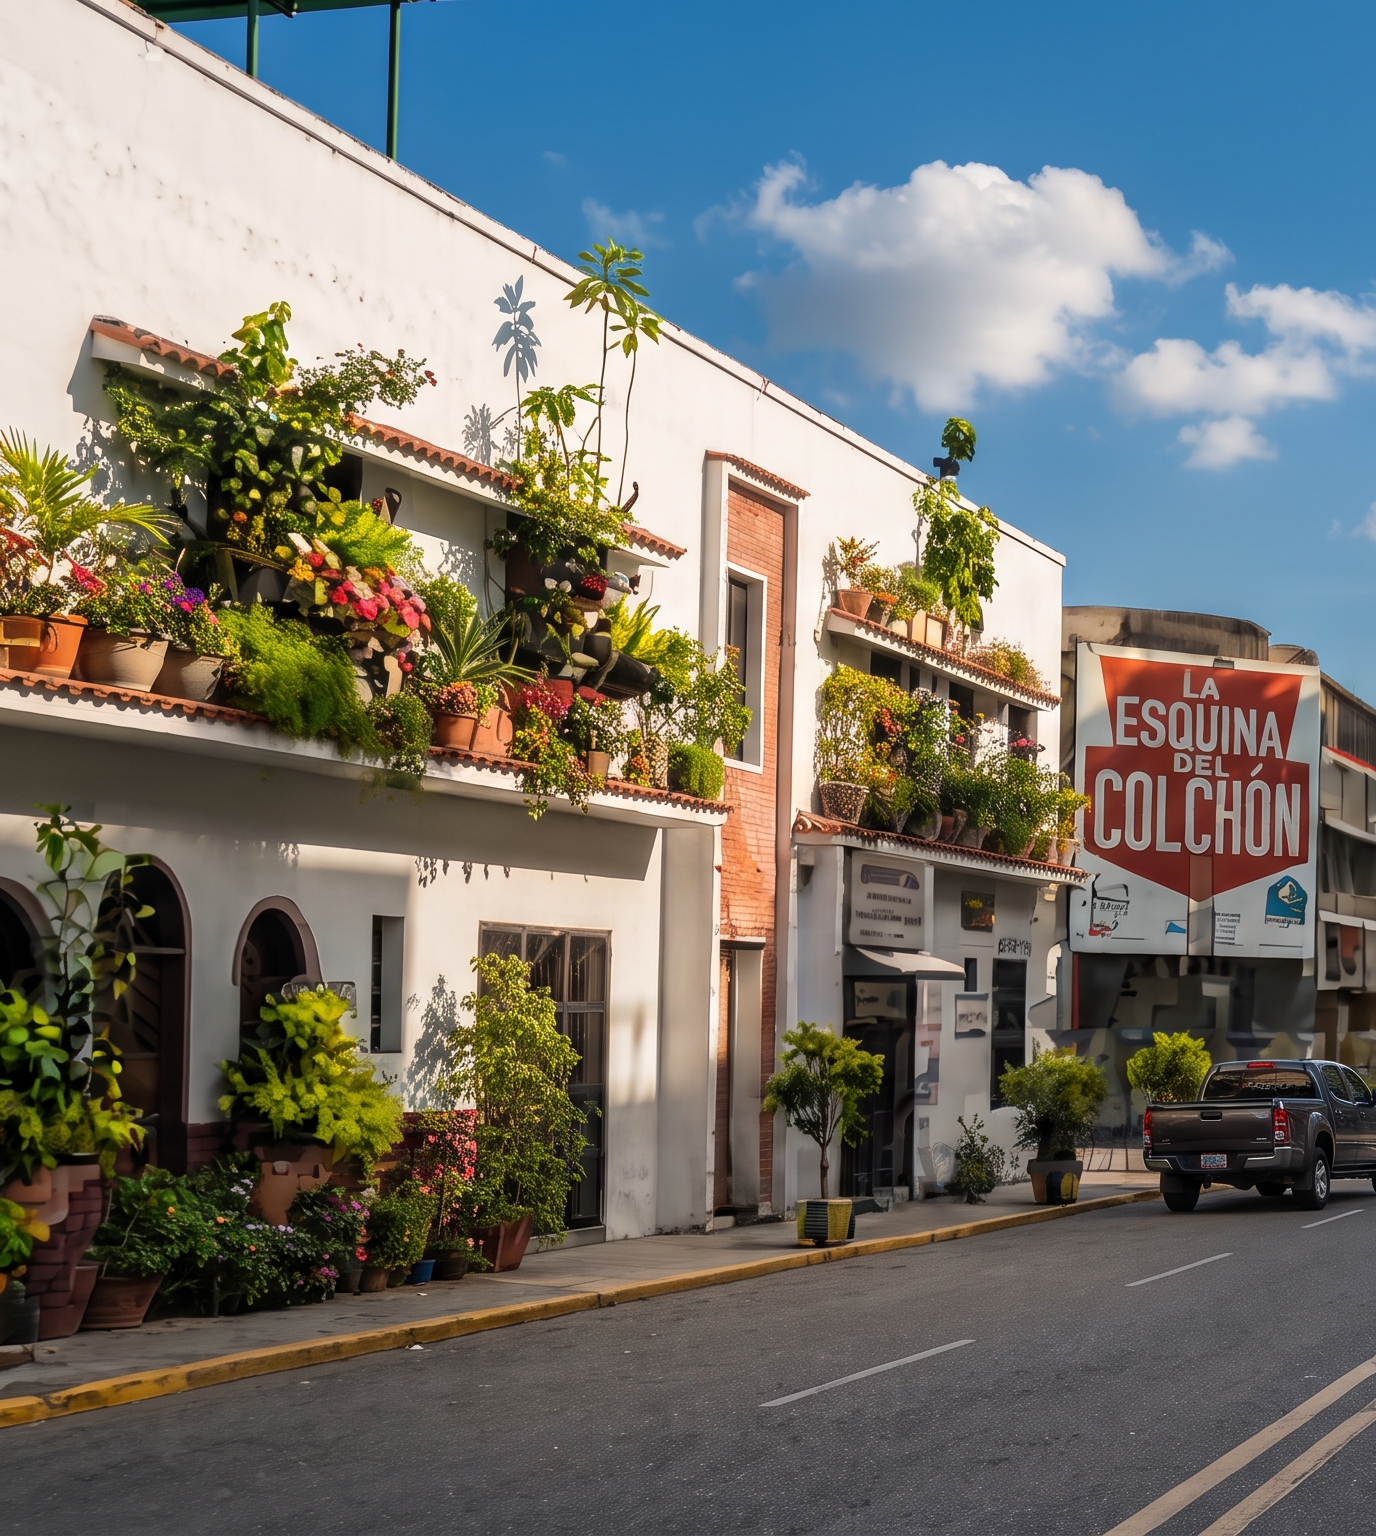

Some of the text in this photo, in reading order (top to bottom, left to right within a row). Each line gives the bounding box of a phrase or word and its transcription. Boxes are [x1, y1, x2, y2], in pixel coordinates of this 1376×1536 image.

[1183, 668, 1220, 700] LA
[1115, 695, 1284, 759] ESQUINA
[1173, 753, 1230, 777] DEL
[1093, 762, 1301, 857] COLCHÓN
